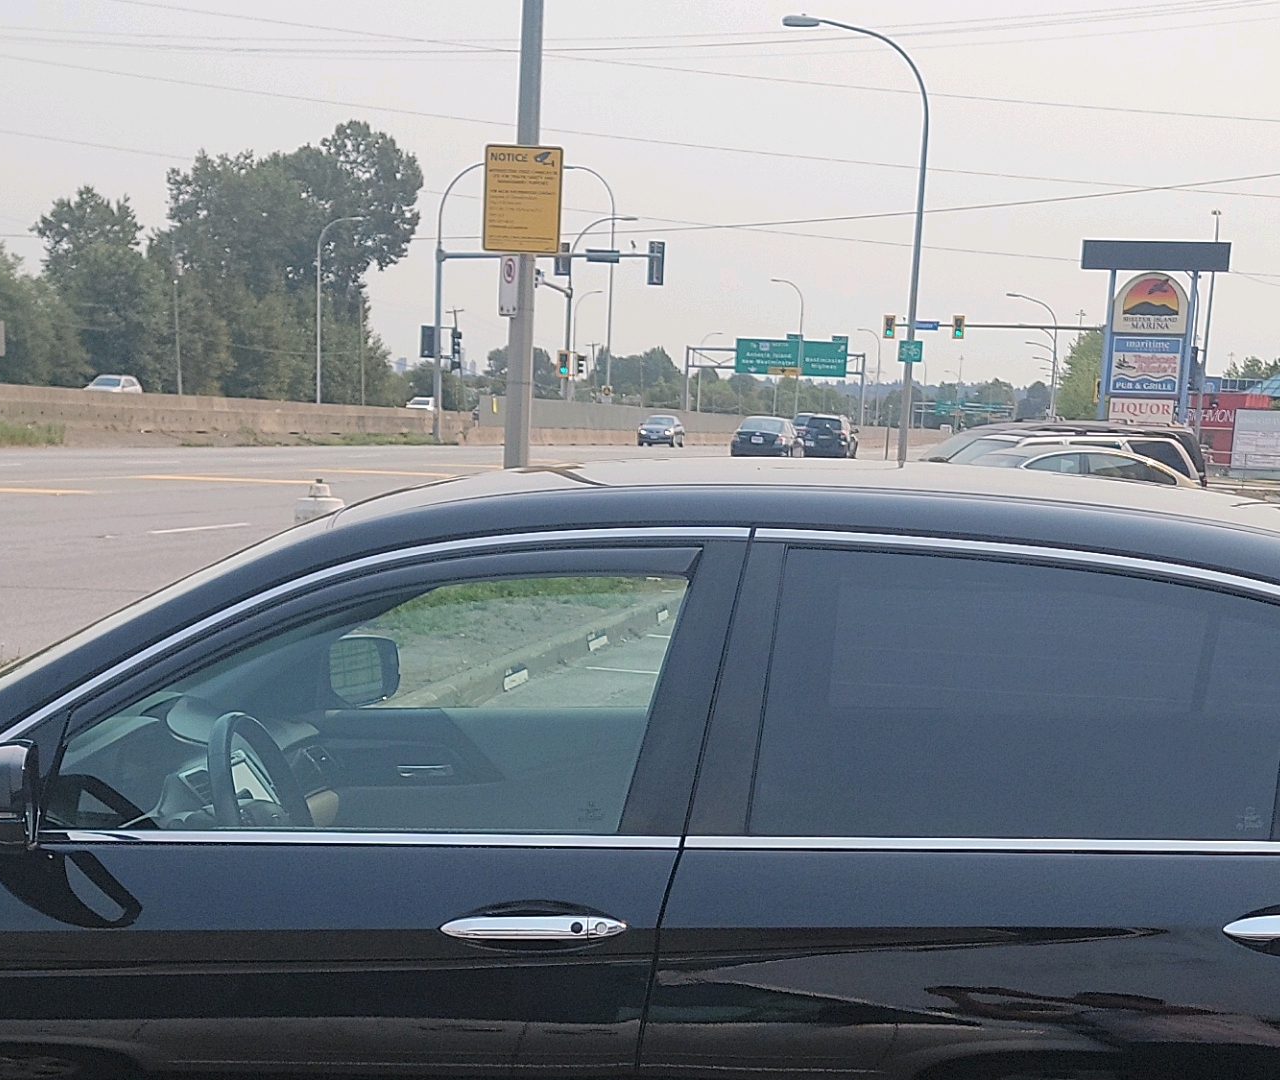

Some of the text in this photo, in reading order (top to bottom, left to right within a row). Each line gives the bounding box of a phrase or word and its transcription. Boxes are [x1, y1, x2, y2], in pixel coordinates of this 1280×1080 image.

[490, 152, 528, 162] NOTICE
[1131, 321, 1170, 330] MARINA
[1126, 340, 1171, 349] maritime
[1116, 381, 1132, 389] PUB
[1111, 402, 1171, 416] LIQUOR
